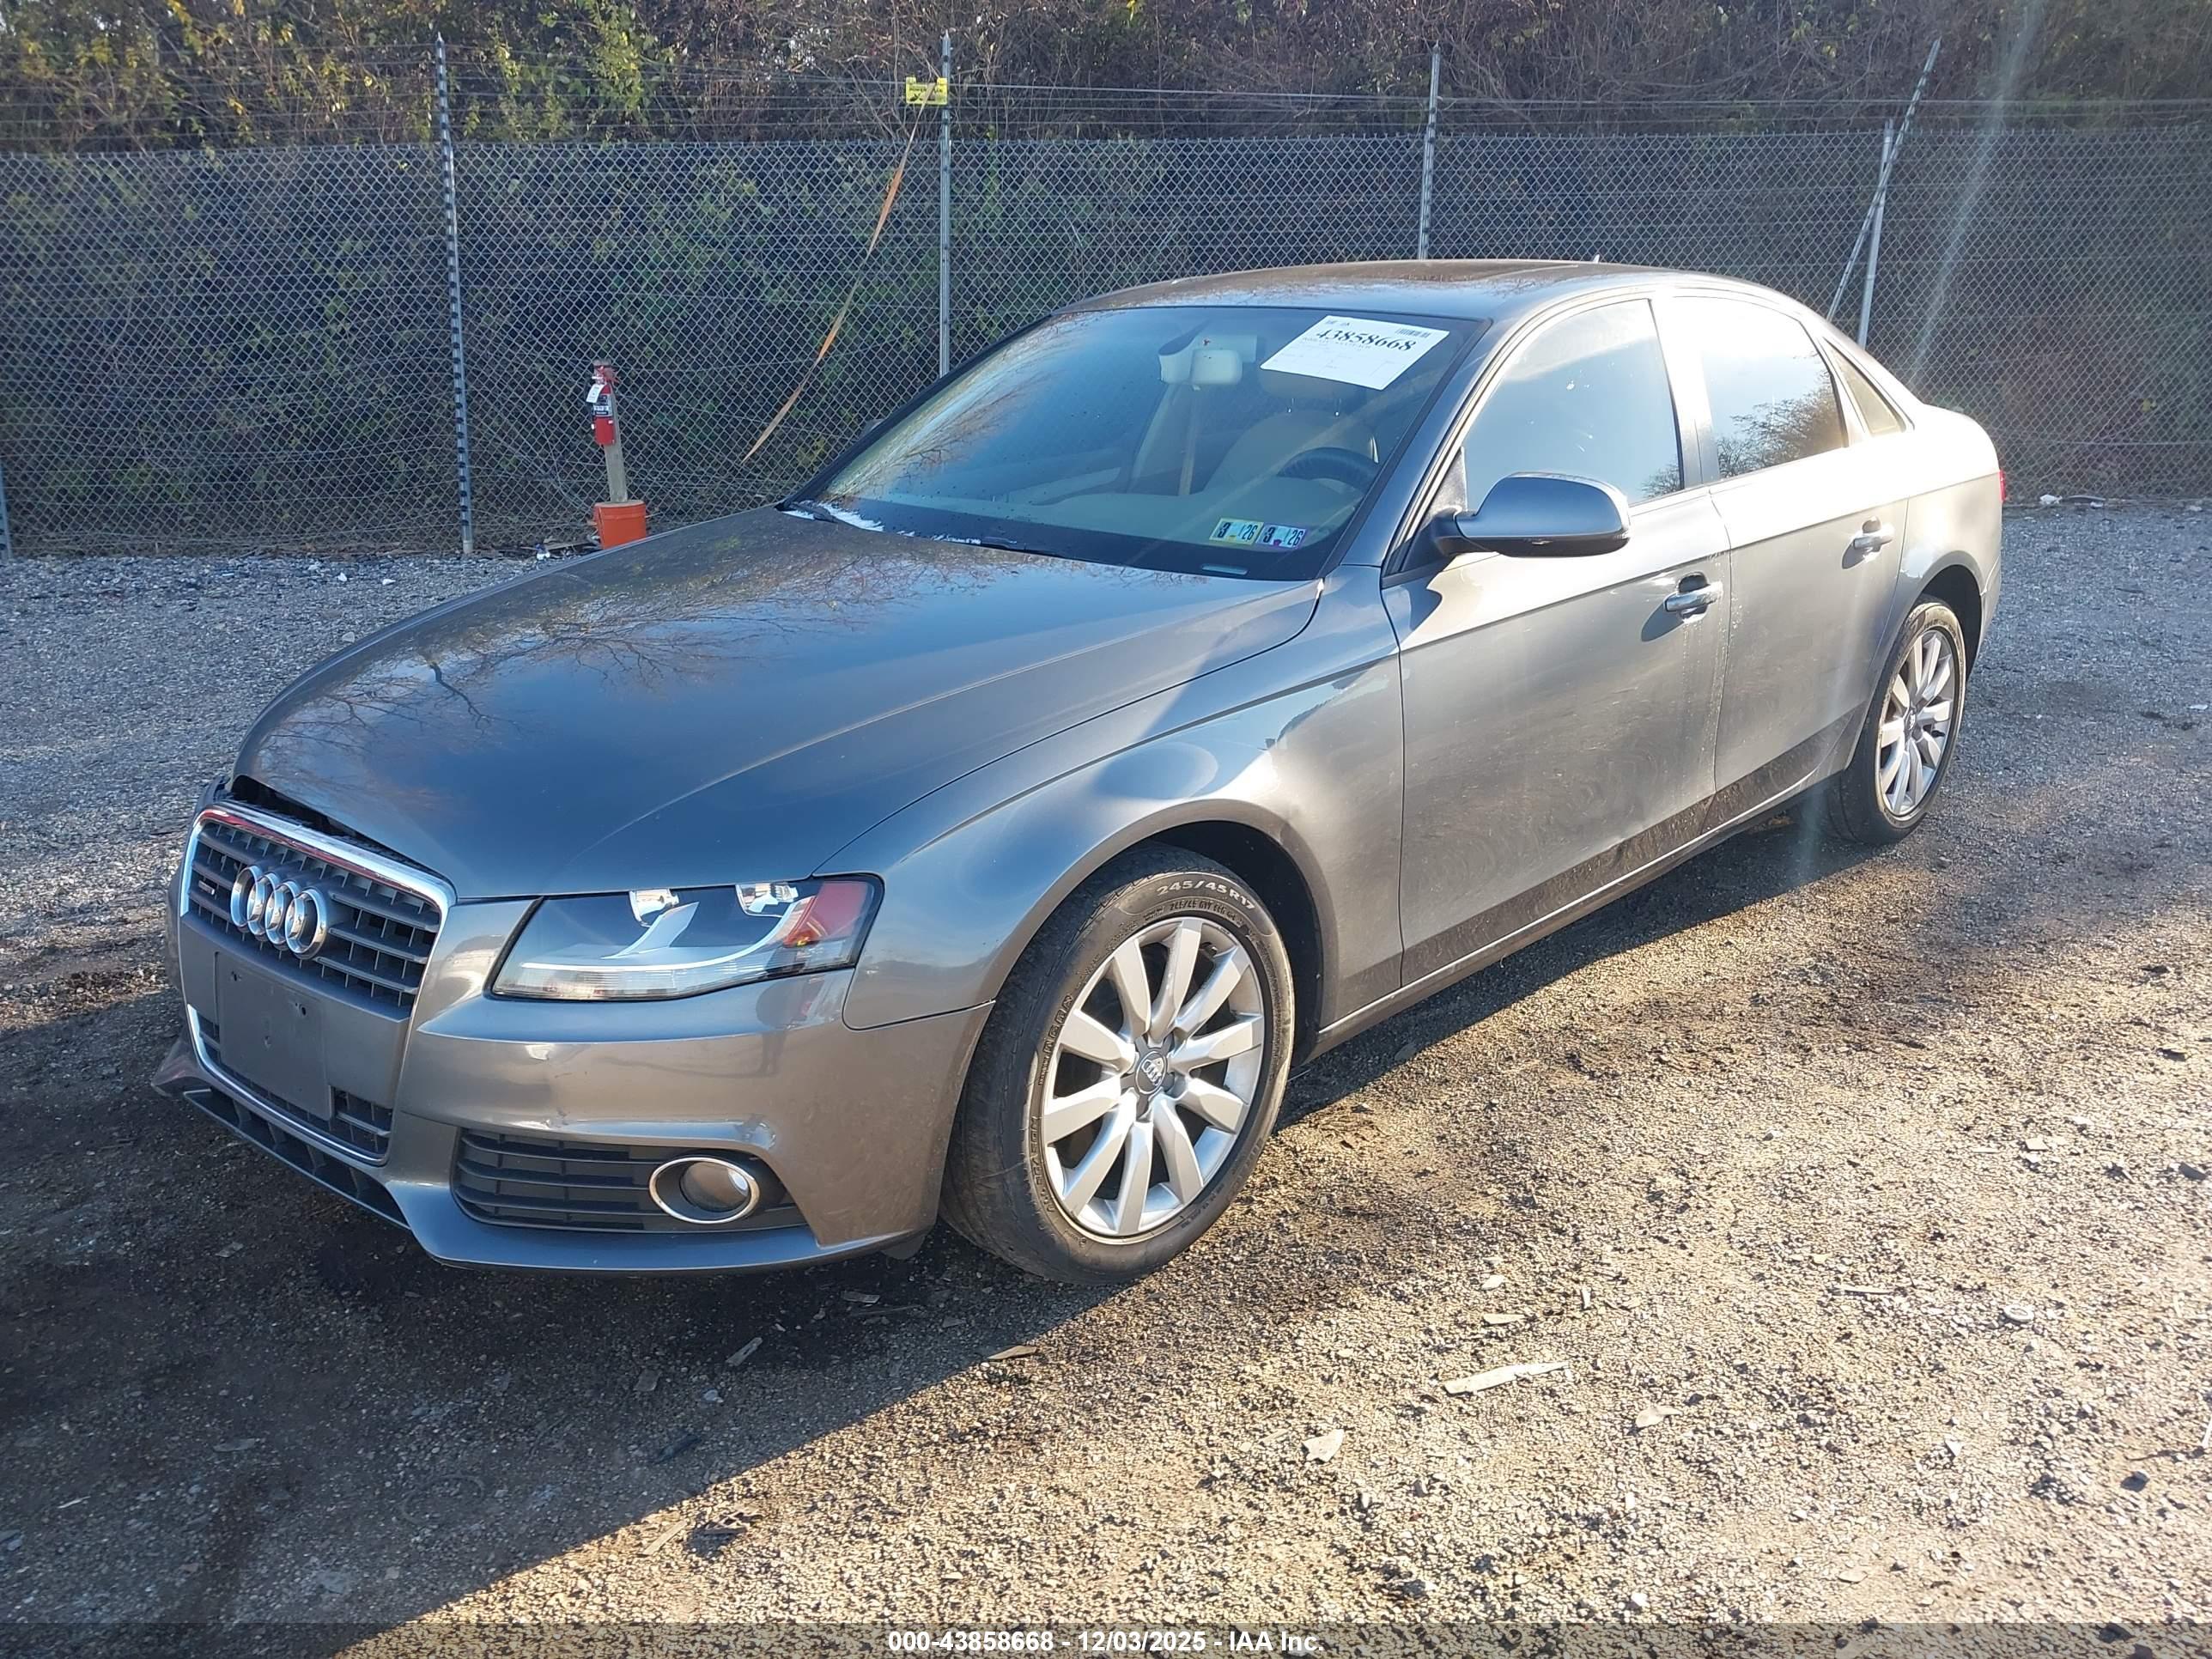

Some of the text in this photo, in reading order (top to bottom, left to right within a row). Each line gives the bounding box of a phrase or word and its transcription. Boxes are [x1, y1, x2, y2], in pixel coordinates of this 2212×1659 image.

[1316, 328, 1417, 351] 43858668
[1217, 521, 1231, 538] 3
[1262, 526, 1276, 544] 3
[1157, 880, 1256, 910] 245/45 R17
